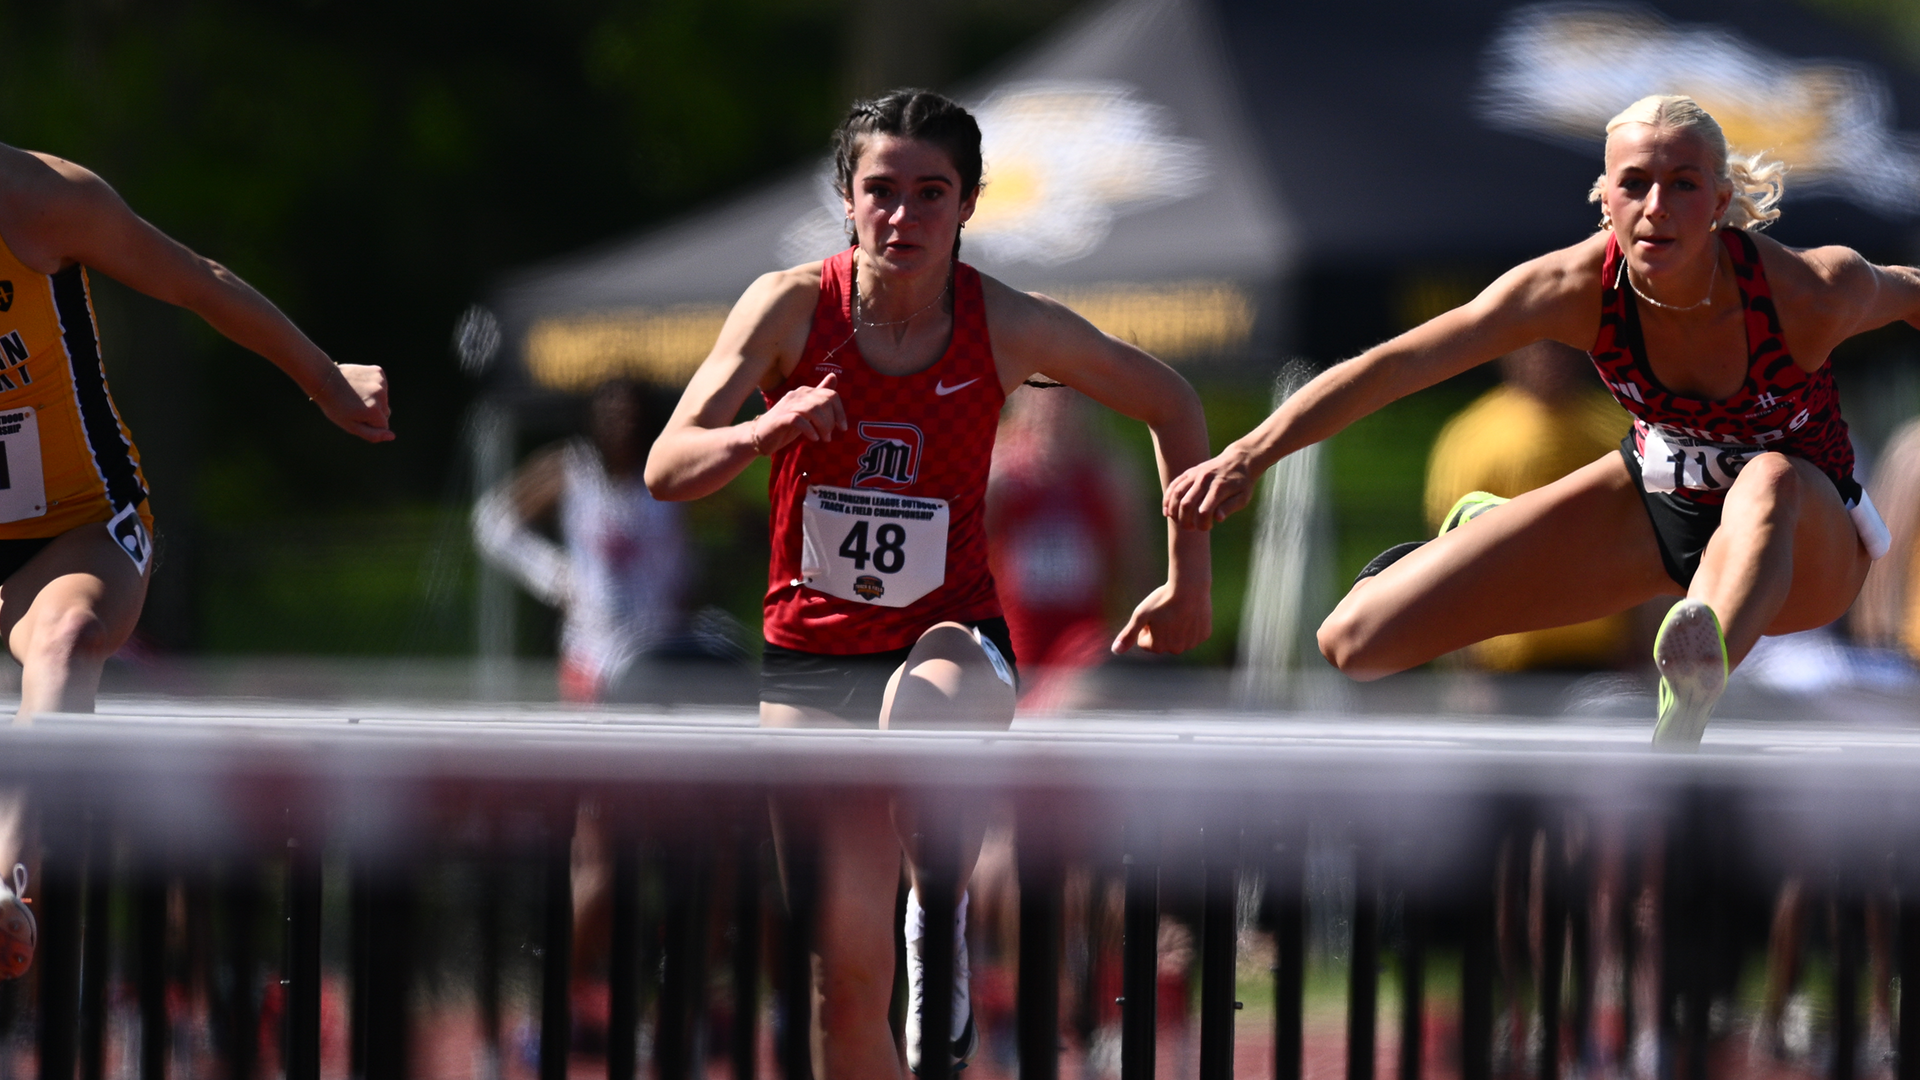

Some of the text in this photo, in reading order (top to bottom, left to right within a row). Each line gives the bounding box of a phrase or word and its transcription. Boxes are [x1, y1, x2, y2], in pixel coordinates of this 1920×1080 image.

[818, 490, 837, 500] 2025
[838, 493, 871, 505] HORIZON
[871, 497, 900, 507] LEAGUE
[820, 501, 935, 520] TRACK & FIELD CHAMPIONSHIP
[839, 520, 906, 574] 48
